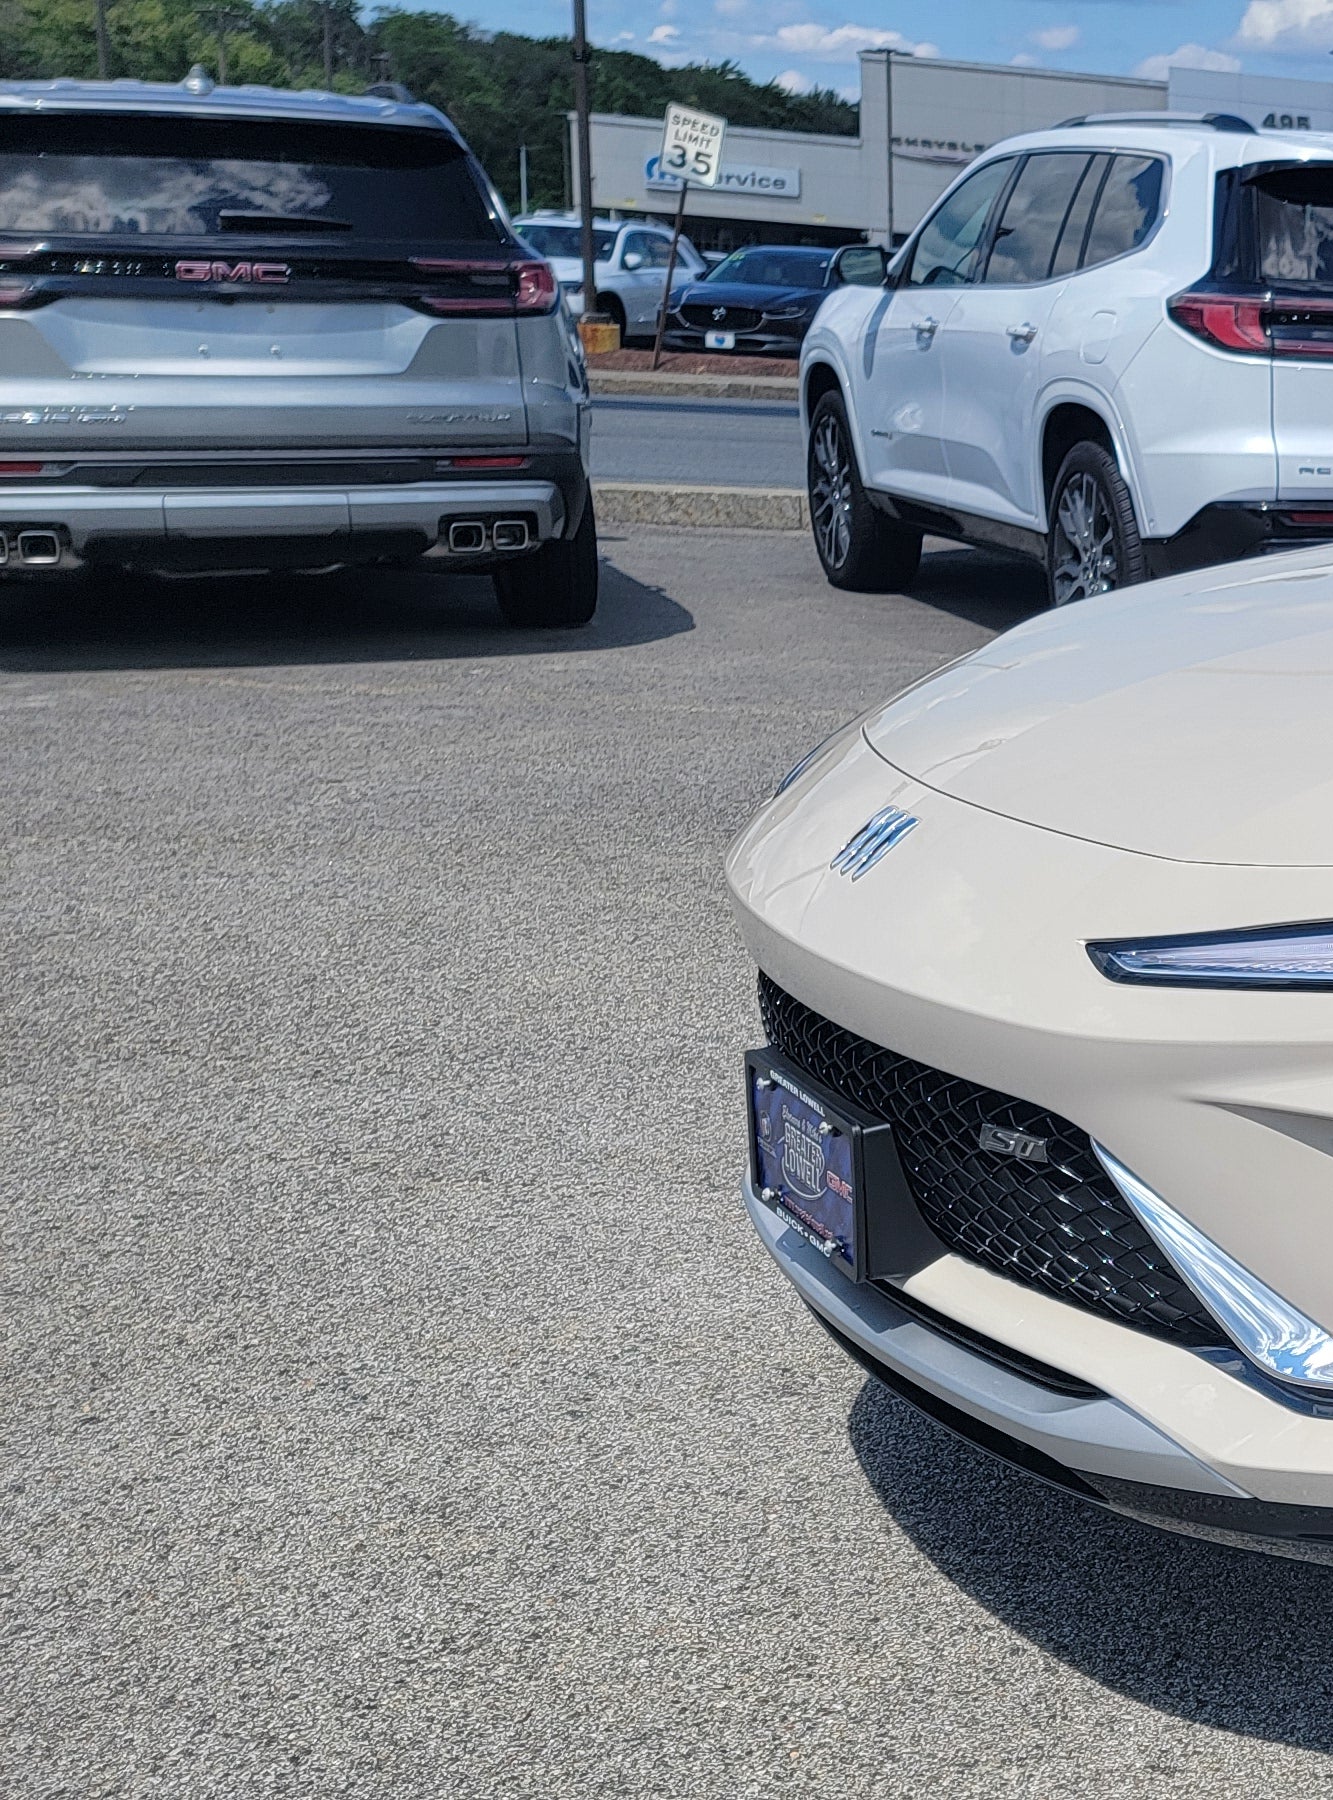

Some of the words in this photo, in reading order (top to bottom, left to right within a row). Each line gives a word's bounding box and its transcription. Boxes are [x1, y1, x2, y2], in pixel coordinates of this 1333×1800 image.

[671, 113, 720, 137] SPEED
[673, 128, 713, 149] LIMIT
[889, 136, 996, 153] CHRYSLE
[666, 144, 713, 176] 35
[718, 171, 787, 190] rvice
[175, 259, 291, 284] GMC
[769, 1069, 801, 1099] GREATER
[799, 1088, 826, 1118] LOWELL
[784, 1121, 822, 1168] GREATER
[985, 1129, 1045, 1157] ST
[784, 1144, 822, 1193] LOWELL
[826, 1170, 854, 1204] GMC
[776, 1206, 804, 1237] BUICK
[809, 1231, 832, 1258] GMC
